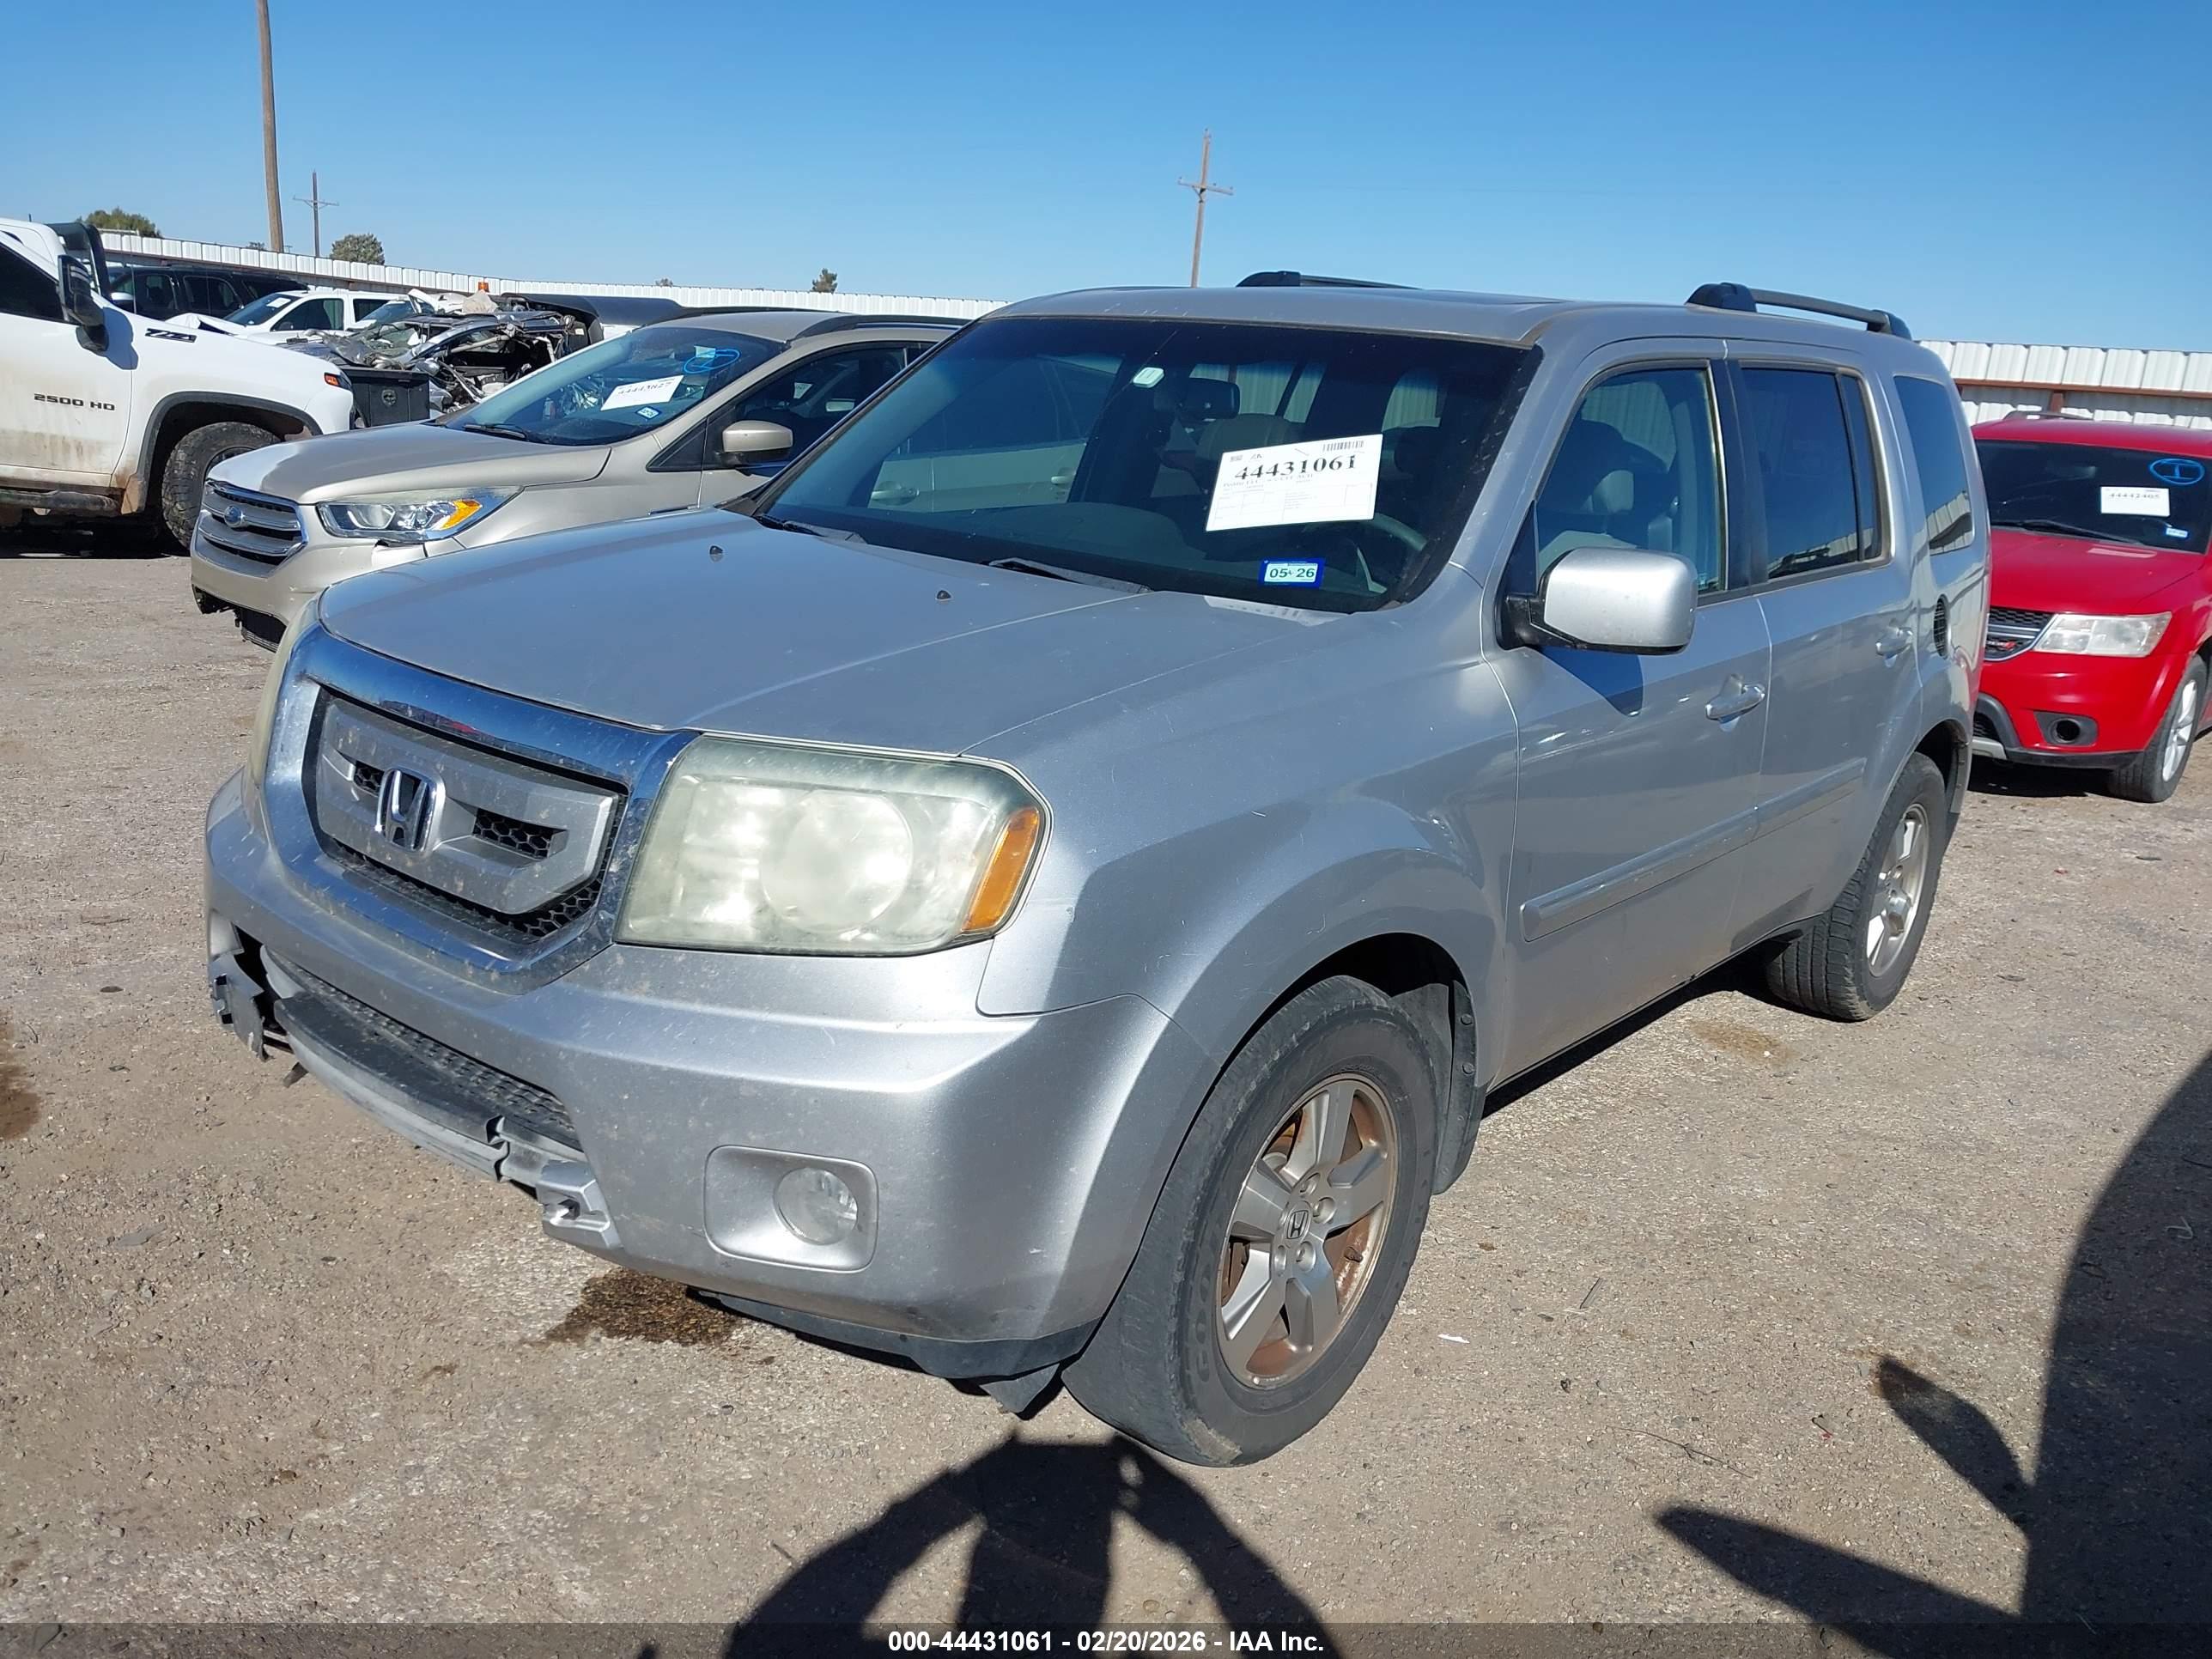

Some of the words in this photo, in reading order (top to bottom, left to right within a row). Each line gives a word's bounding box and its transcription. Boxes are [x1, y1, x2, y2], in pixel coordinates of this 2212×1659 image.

[34, 392, 84, 407] 2500
[90, 401, 115, 410] HD
[1234, 454, 1357, 480] 44431061
[1269, 568, 1288, 579] 05
[1296, 568, 1316, 578] 26
